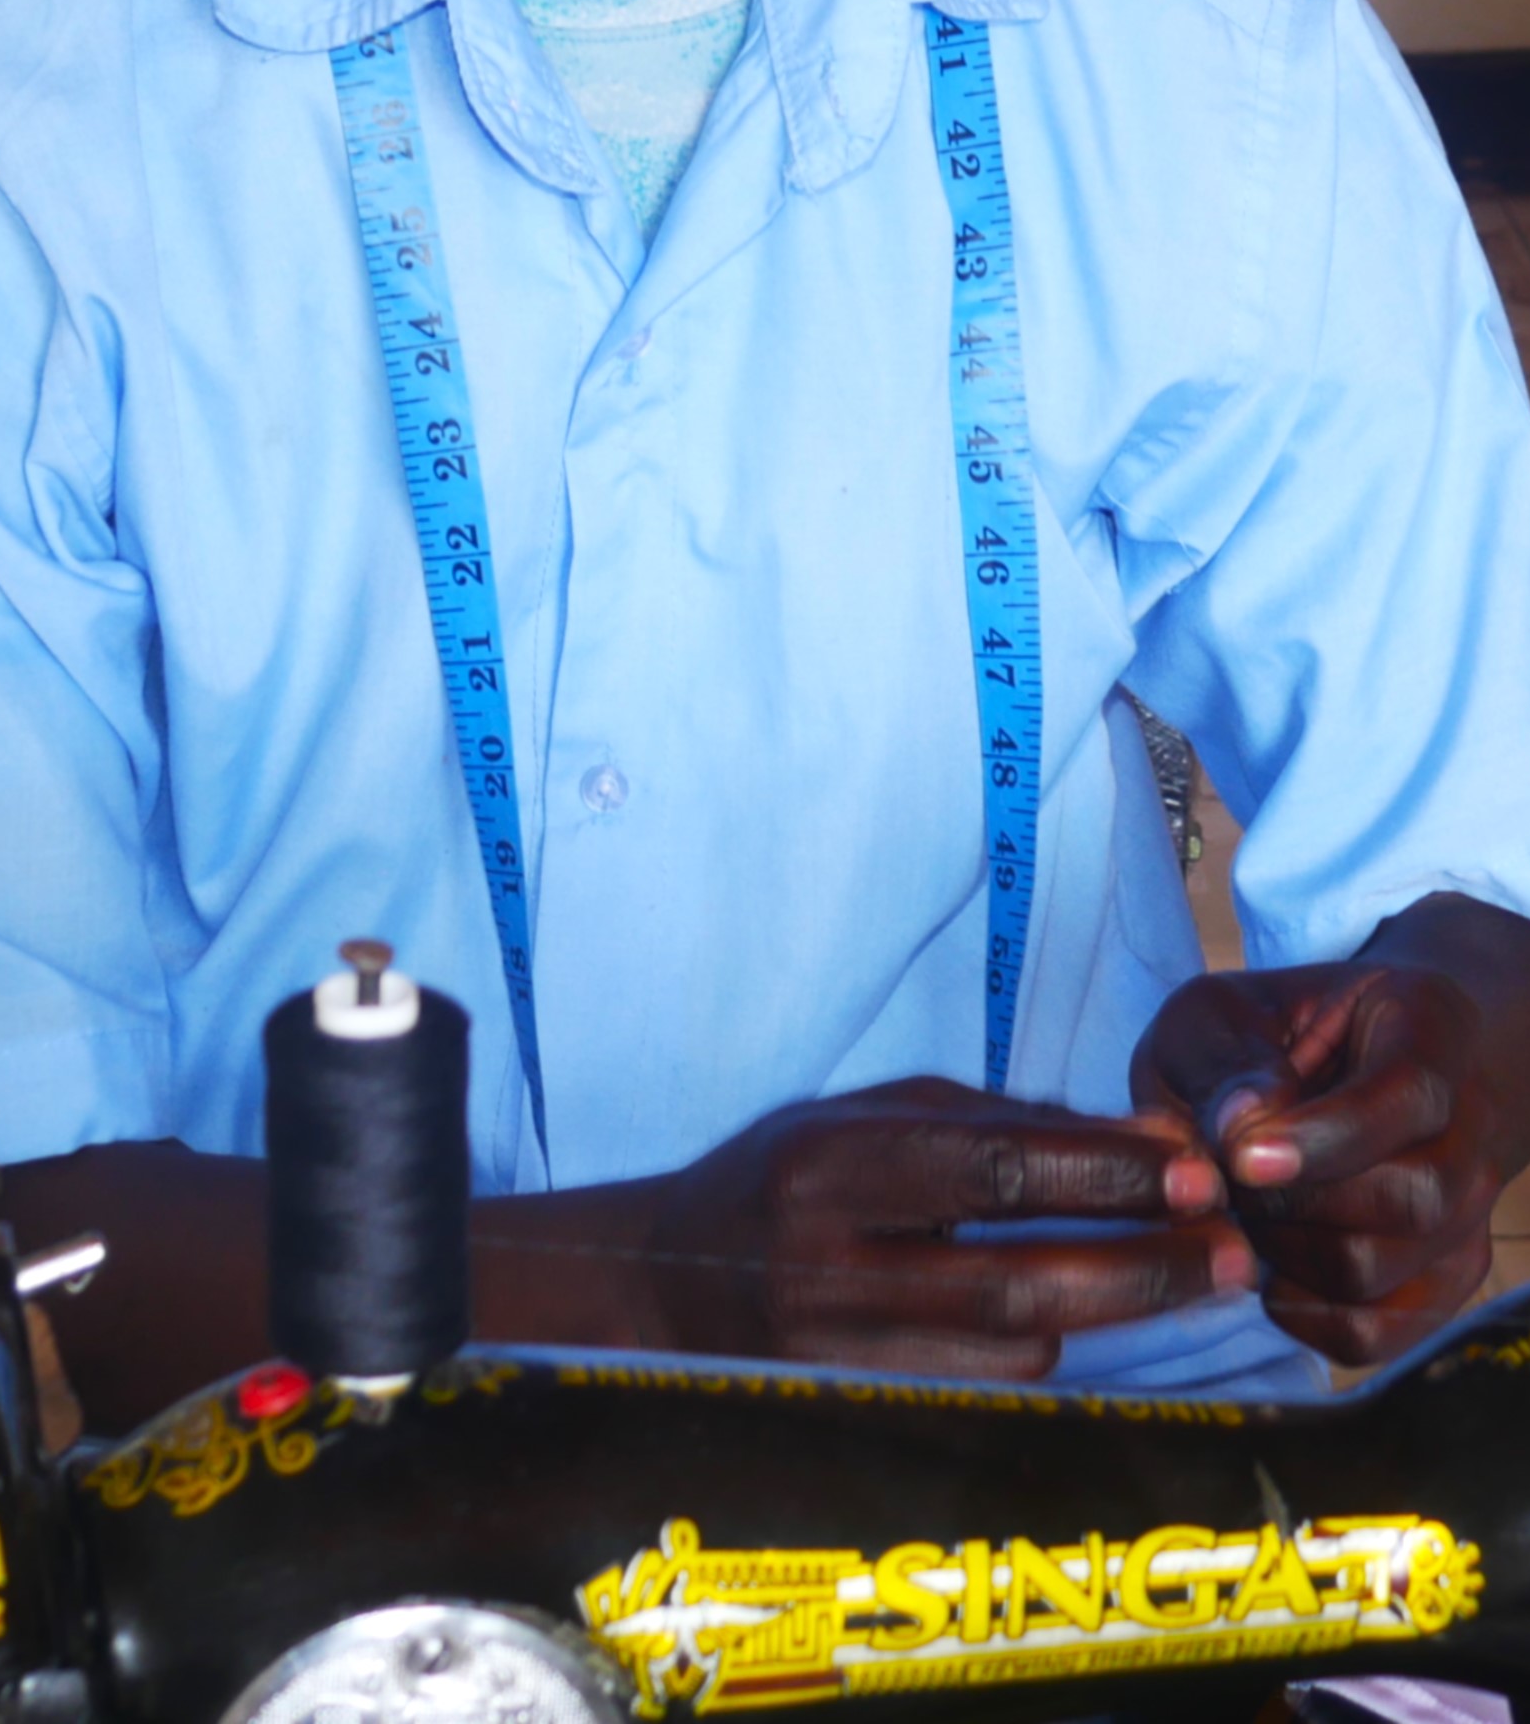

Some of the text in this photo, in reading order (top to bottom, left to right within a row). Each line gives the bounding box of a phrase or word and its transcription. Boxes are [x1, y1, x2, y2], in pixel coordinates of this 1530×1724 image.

[371, 98, 415, 163] 26
[390, 205, 435, 272] 25
[406, 309, 452, 376] 24
[425, 415, 469, 484] 23
[933, 15, 1020, 997] 41 42 43 44 45 46 47 48 49 50
[444, 523, 486, 588] 22
[461, 628, 501, 694] 21
[477, 733, 510, 800] 20
[494, 837, 522, 899] 19
[870, 1522, 1323, 1652] SINGA
